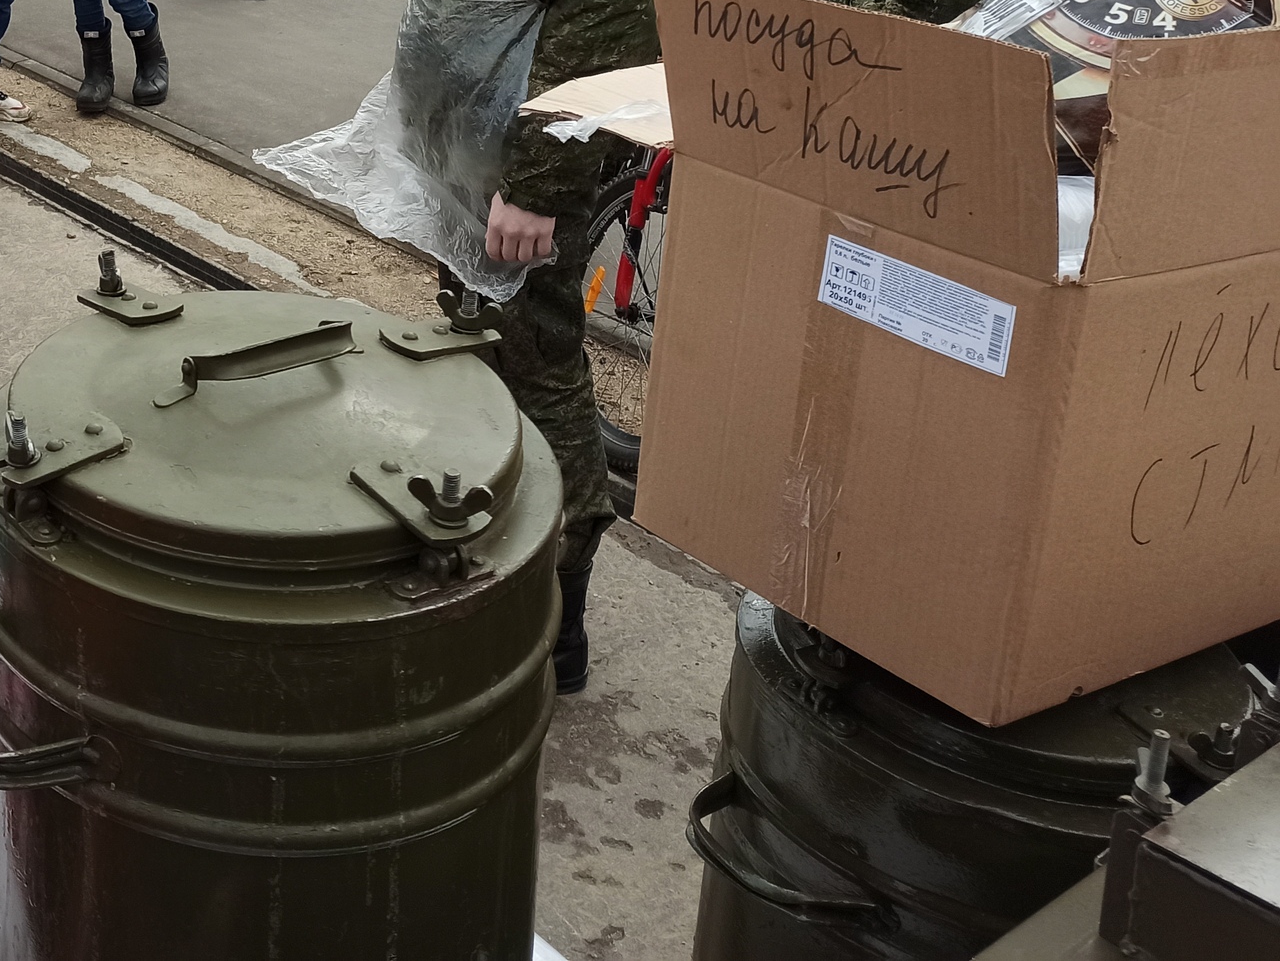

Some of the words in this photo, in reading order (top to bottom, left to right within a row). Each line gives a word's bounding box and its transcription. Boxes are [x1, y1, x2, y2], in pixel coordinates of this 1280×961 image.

[1104, 2, 1134, 24] 5
[1153, 9, 1177, 31] 4
[711, 78, 777, 134] на
